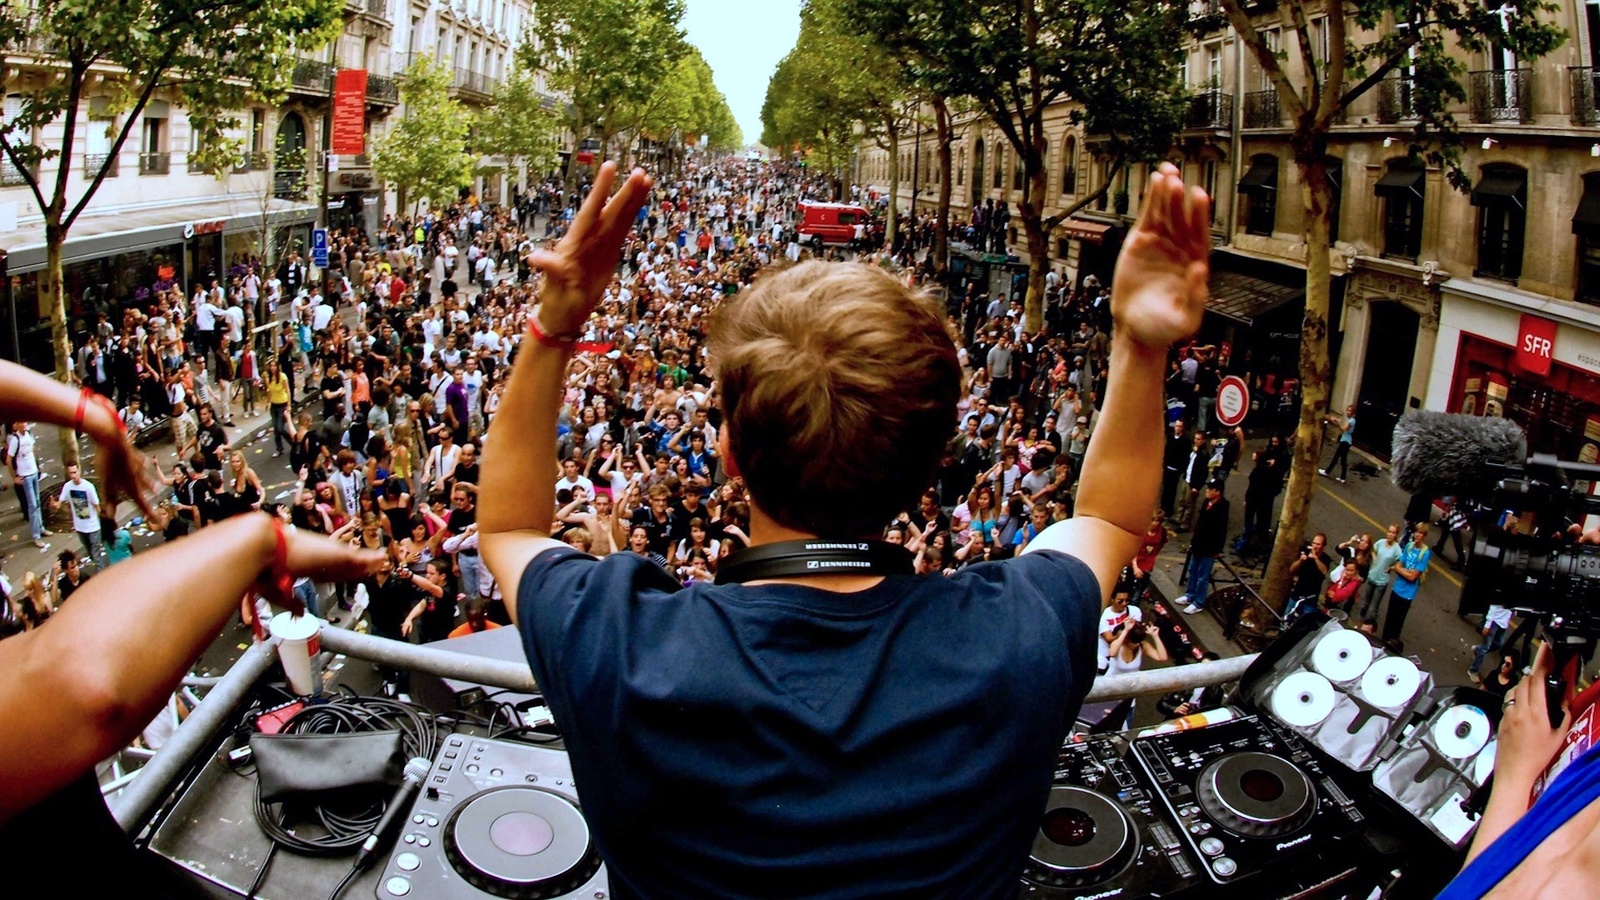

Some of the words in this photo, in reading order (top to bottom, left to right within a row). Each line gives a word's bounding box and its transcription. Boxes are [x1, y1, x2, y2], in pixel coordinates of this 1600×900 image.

[315, 232, 323, 246] P
[1523, 334, 1552, 358] SFR
[1276, 833, 1312, 851] Pioneer
